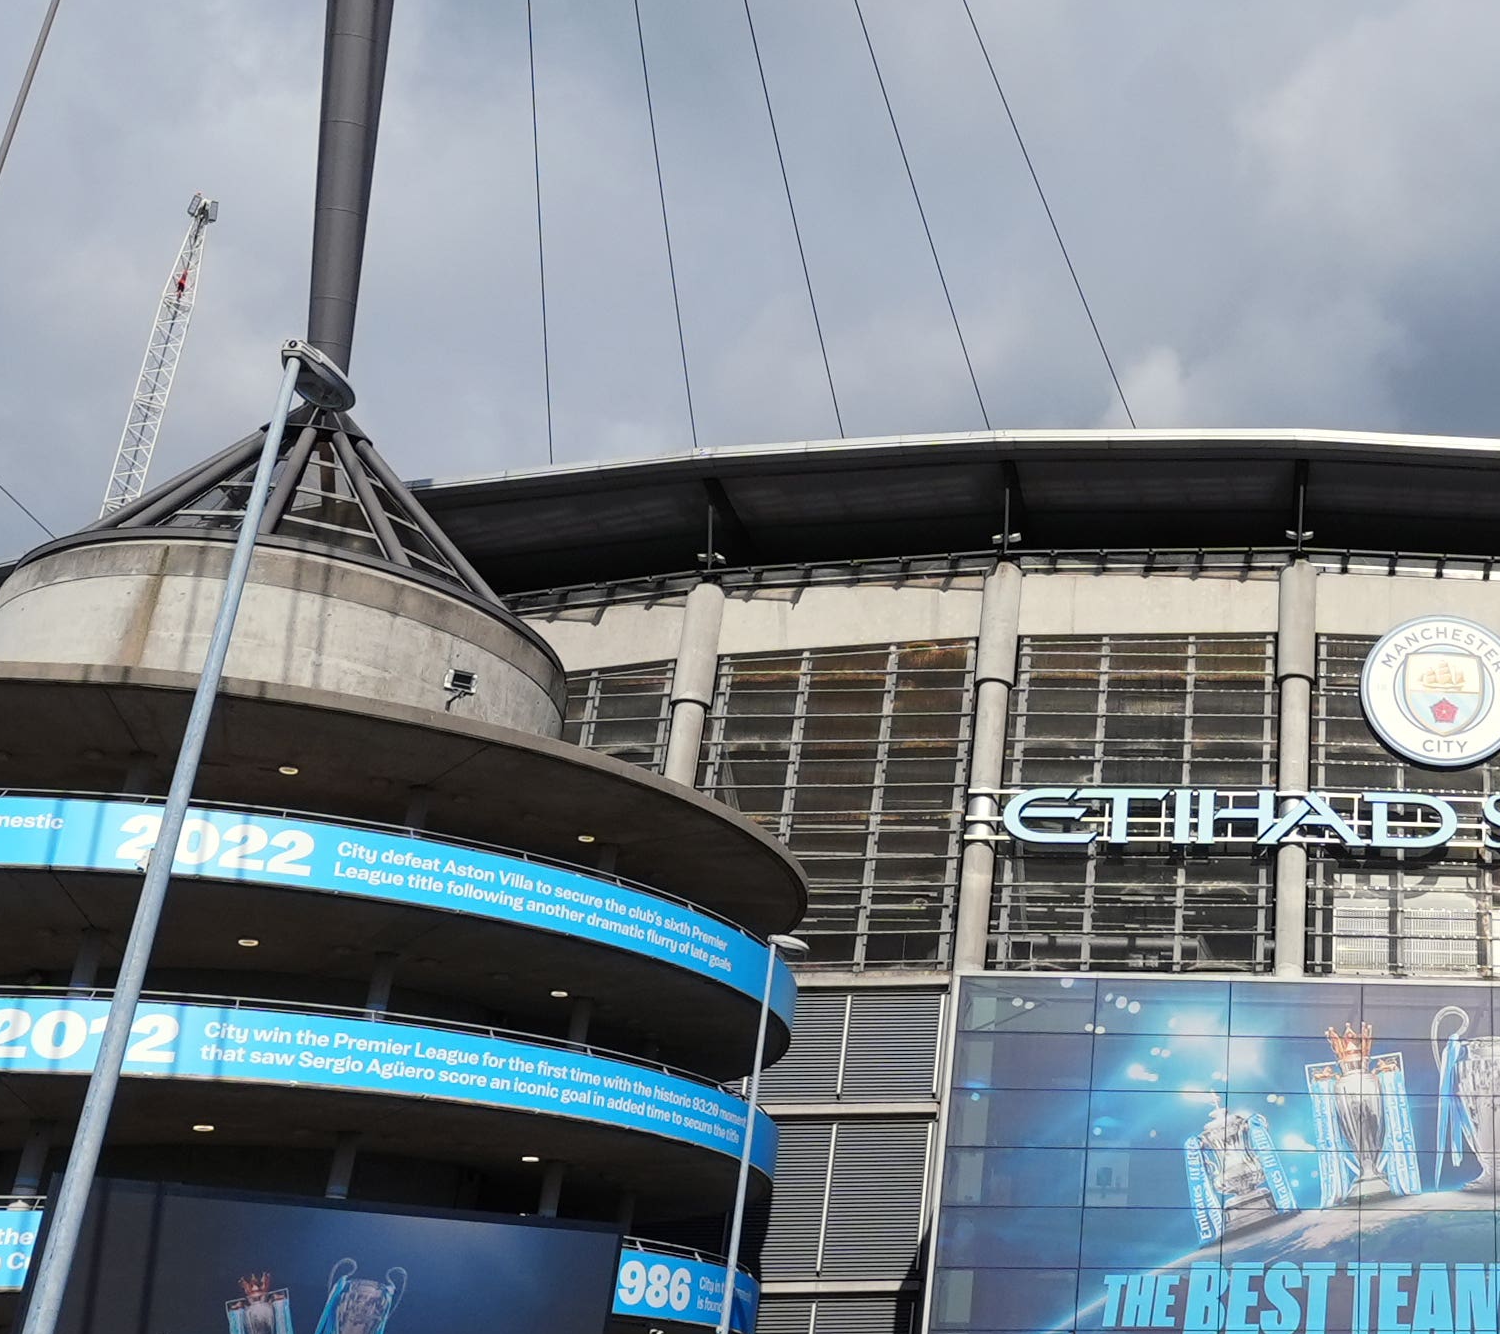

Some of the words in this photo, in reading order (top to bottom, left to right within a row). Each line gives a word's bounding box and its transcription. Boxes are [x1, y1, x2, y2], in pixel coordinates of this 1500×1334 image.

[1422, 739, 1468, 753] CITY
[1003, 787, 1458, 850] ETIHAD
[115, 814, 316, 877] 2022
[337, 841, 379, 865] City
[381, 847, 441, 873] defeat
[443, 859, 496, 883] Aston
[499, 870, 533, 892] Villa
[536, 879, 552, 895] to
[554, 887, 603, 909] secure
[605, 898, 627, 915] the
[334, 861, 404, 887] League
[408, 872, 444, 894] title
[447, 881, 524, 911] following
[526, 898, 585, 923] another
[586, 912, 645, 940] dramatic
[200, 1044, 245, 1063] that
[249, 1049, 295, 1067] saw
[298, 1051, 363, 1074] Sergio
[366, 1056, 436, 1081] Agüero
[438, 1069, 488, 1088] score
[490, 1076, 511, 1091] an
[513, 1078, 559, 1099] iconic
[560, 1086, 591, 1105] goal
[606, 1095, 644, 1117] added
[204, 1021, 248, 1044] City
[251, 1026, 292, 1044] win
[296, 1028, 329, 1047] the
[333, 1032, 413, 1056] Premier
[415, 1041, 479, 1066] League
[482, 1051, 507, 1069] for
[508, 1056, 534, 1075] the
[537, 1059, 569, 1080] first
[570, 1067, 600, 1086] time
[603, 1074, 632, 1094] with
[1102, 1274, 1180, 1327] THE
